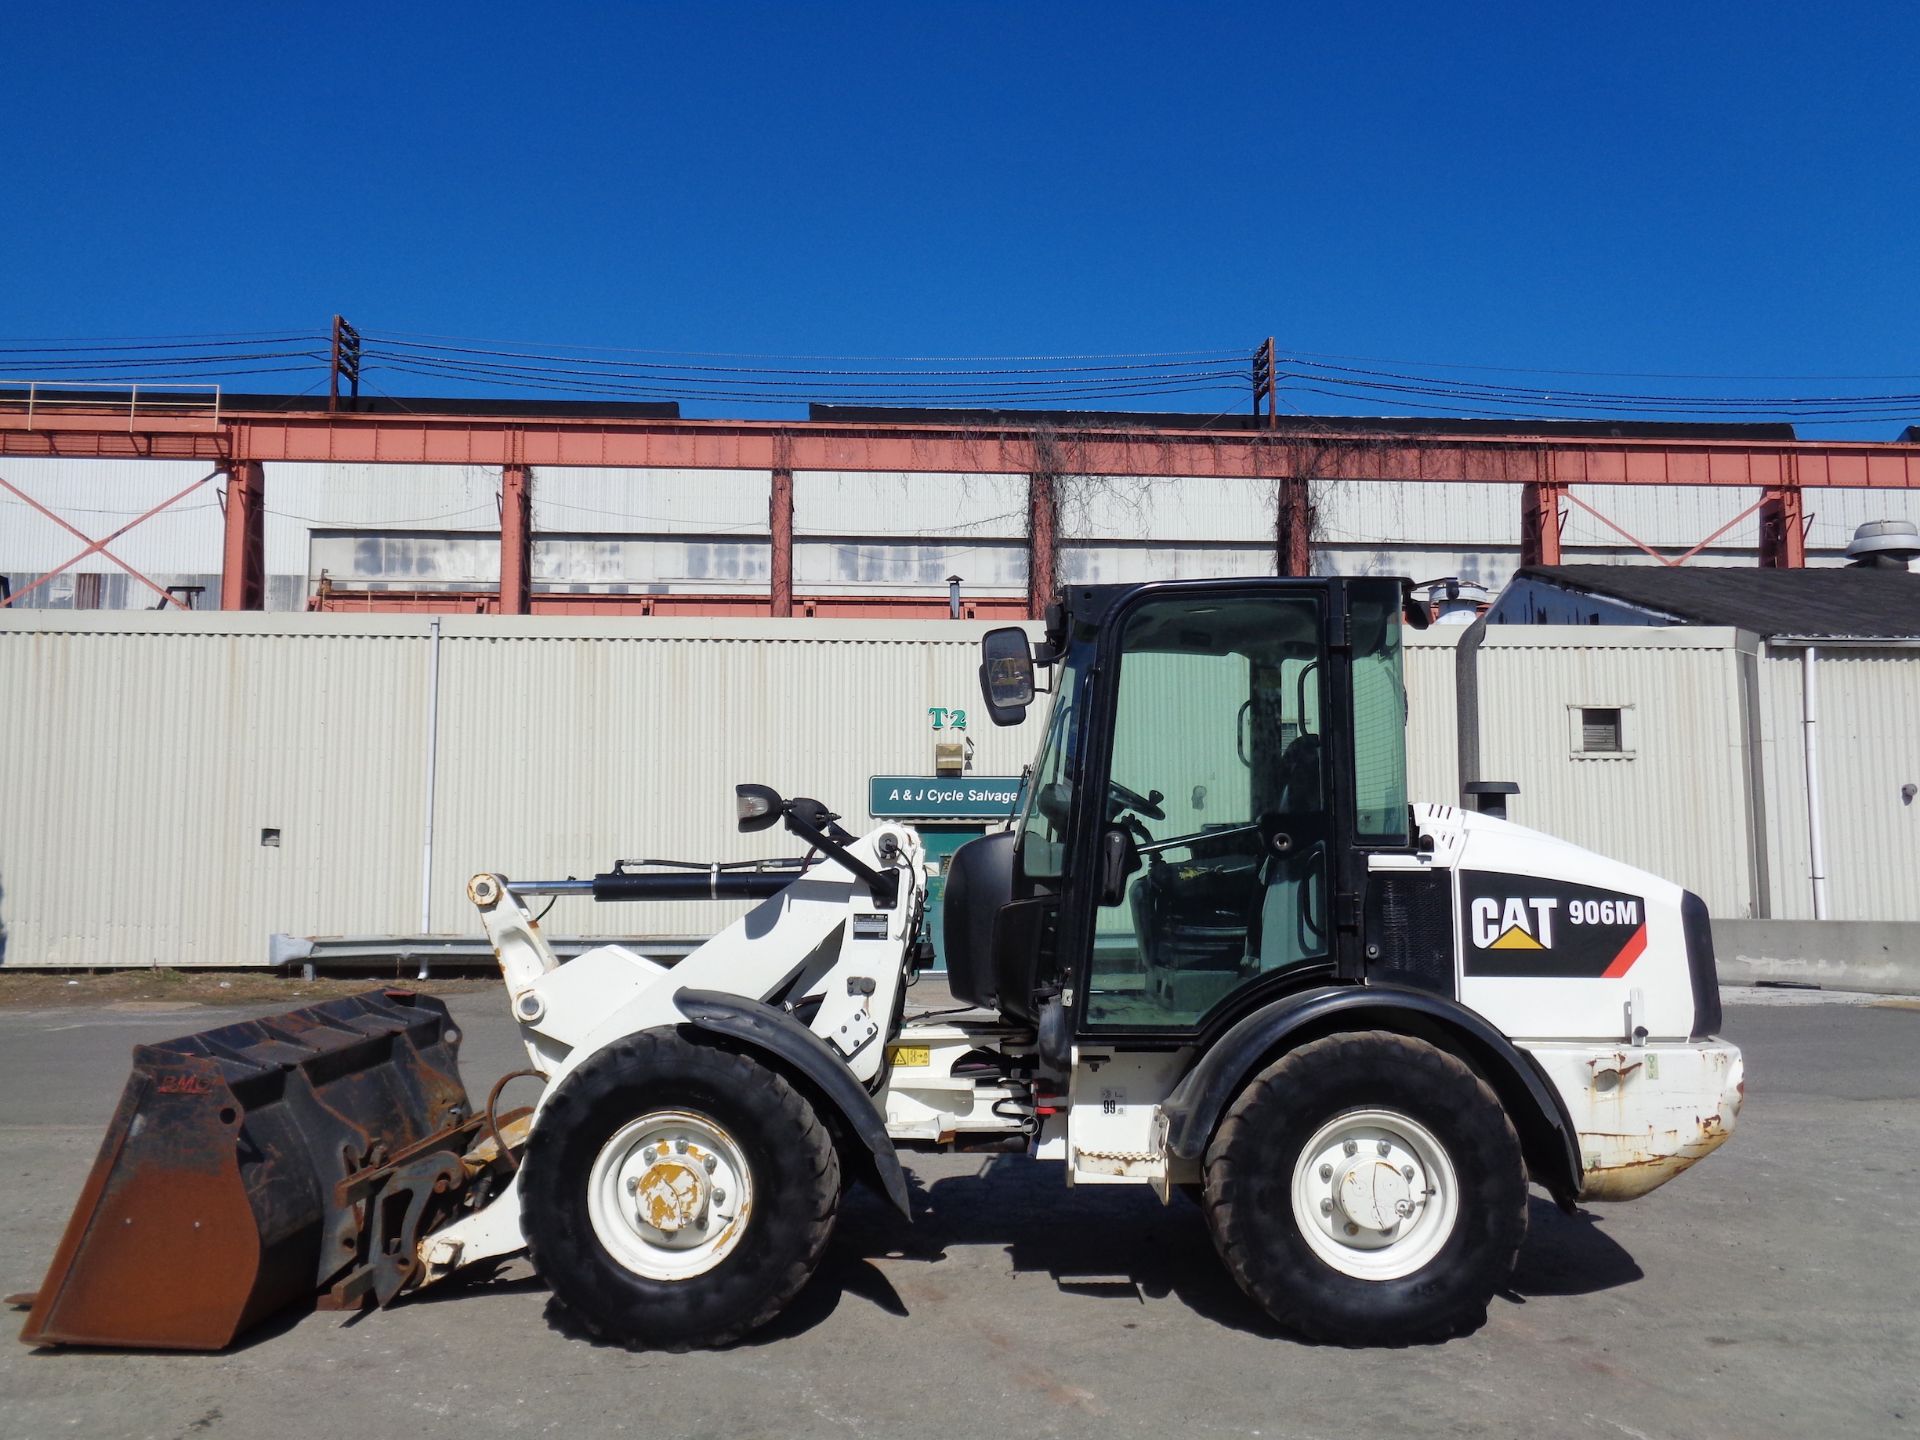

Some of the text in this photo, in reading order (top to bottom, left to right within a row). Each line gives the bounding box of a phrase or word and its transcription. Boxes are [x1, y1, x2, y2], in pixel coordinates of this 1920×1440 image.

[928, 707, 967, 729] T2
[889, 789, 1018, 803] A & J Cycle Salvage
[1471, 897, 1638, 949] CAT 906M
[1103, 1099, 1116, 1114] 99
